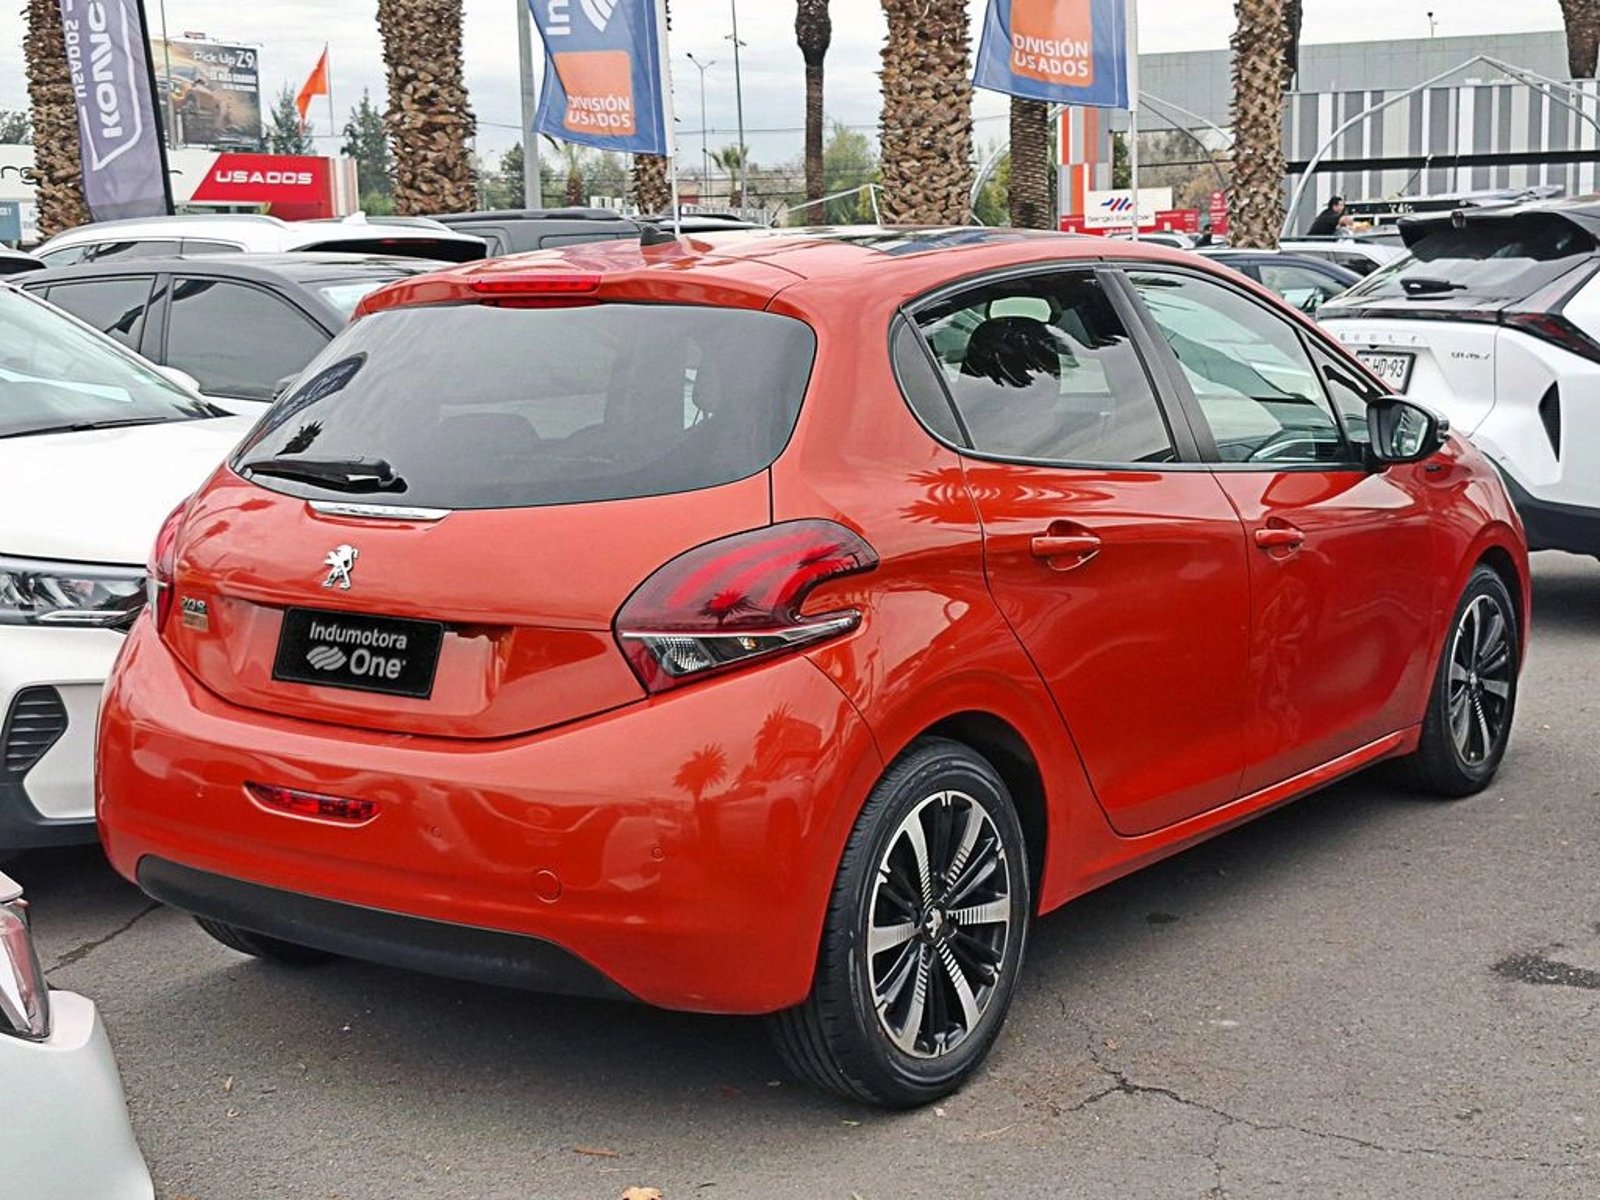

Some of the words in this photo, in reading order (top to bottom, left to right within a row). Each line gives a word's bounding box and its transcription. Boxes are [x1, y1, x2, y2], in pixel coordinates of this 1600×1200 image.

[1013, 33, 1089, 58] DIVISIÓN
[219, 53, 235, 66] Up
[235, 51, 255, 68] Z9
[1014, 50, 1089, 77] USADOS
[568, 110, 632, 128] USADOS
[215, 170, 313, 185] USADOS
[309, 621, 408, 650] Indumotora
[349, 648, 402, 679] One
